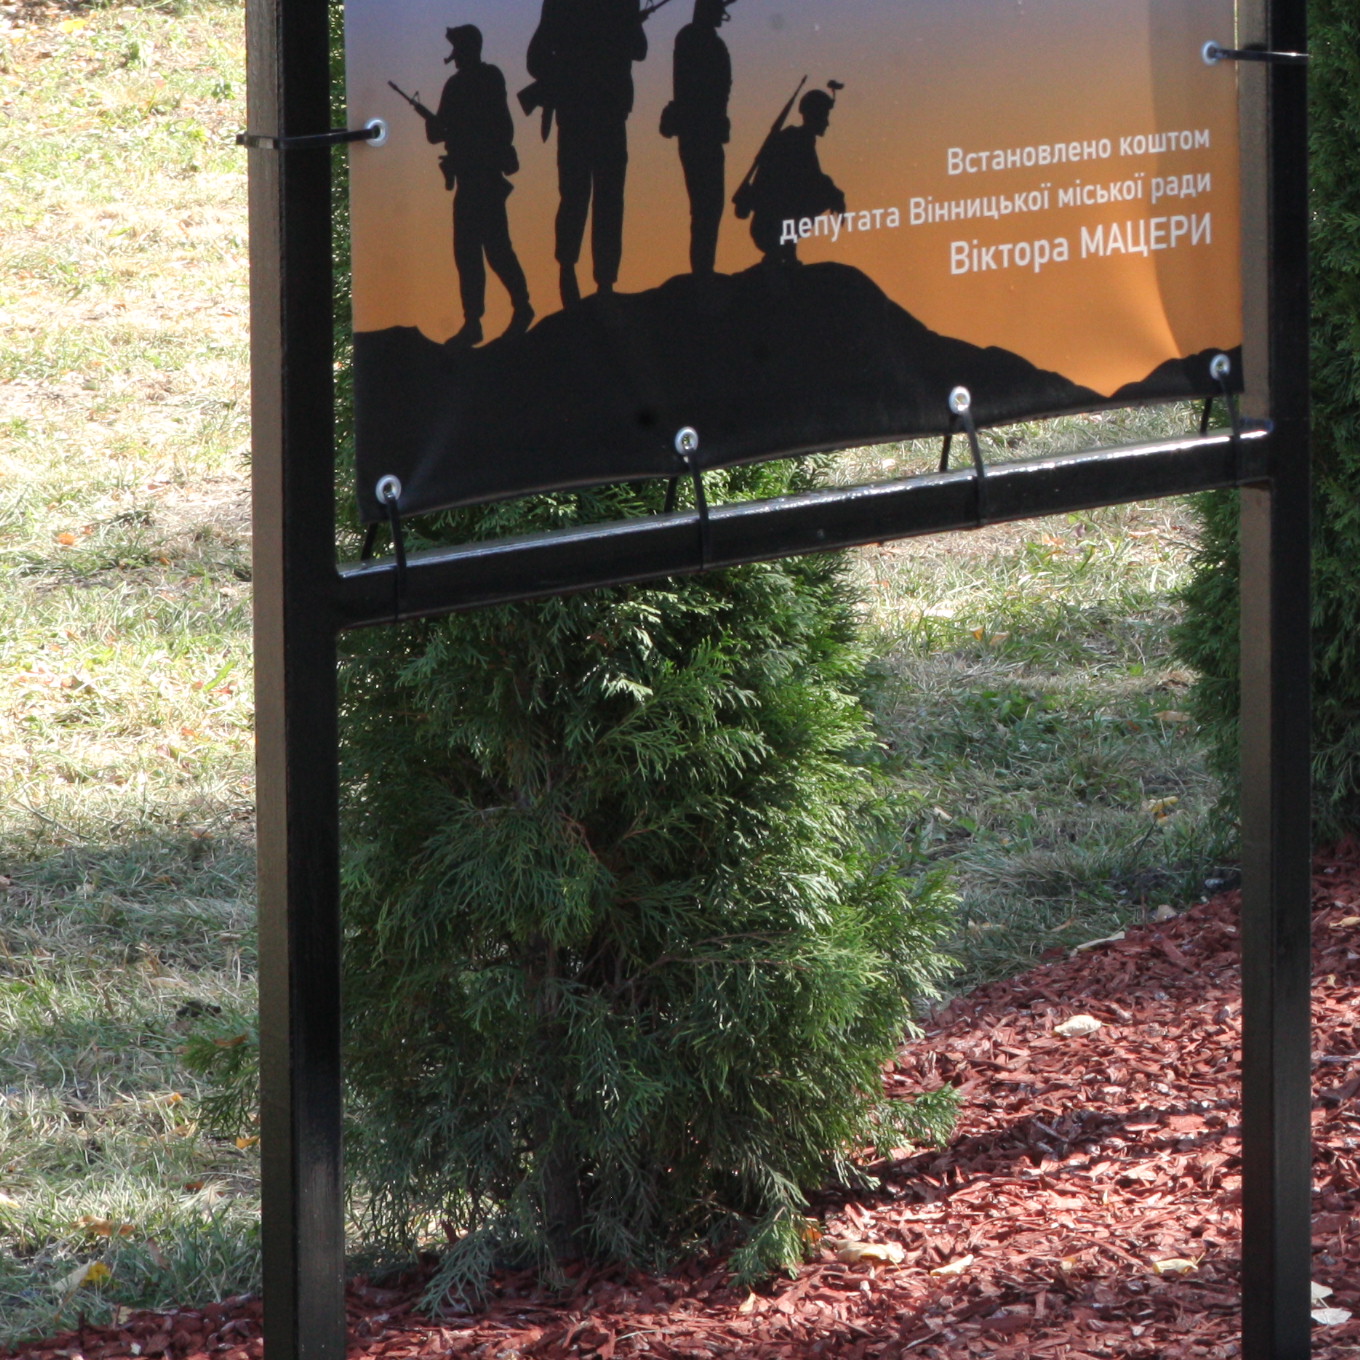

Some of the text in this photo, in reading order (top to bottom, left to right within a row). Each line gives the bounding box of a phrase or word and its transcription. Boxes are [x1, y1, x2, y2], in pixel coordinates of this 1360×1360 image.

[947, 130, 1210, 175] Встановлено коштом
[780, 173, 1211, 244] депутата Вінницької міської ради
[950, 213, 1211, 275] Віктора МАЦЕРИ
